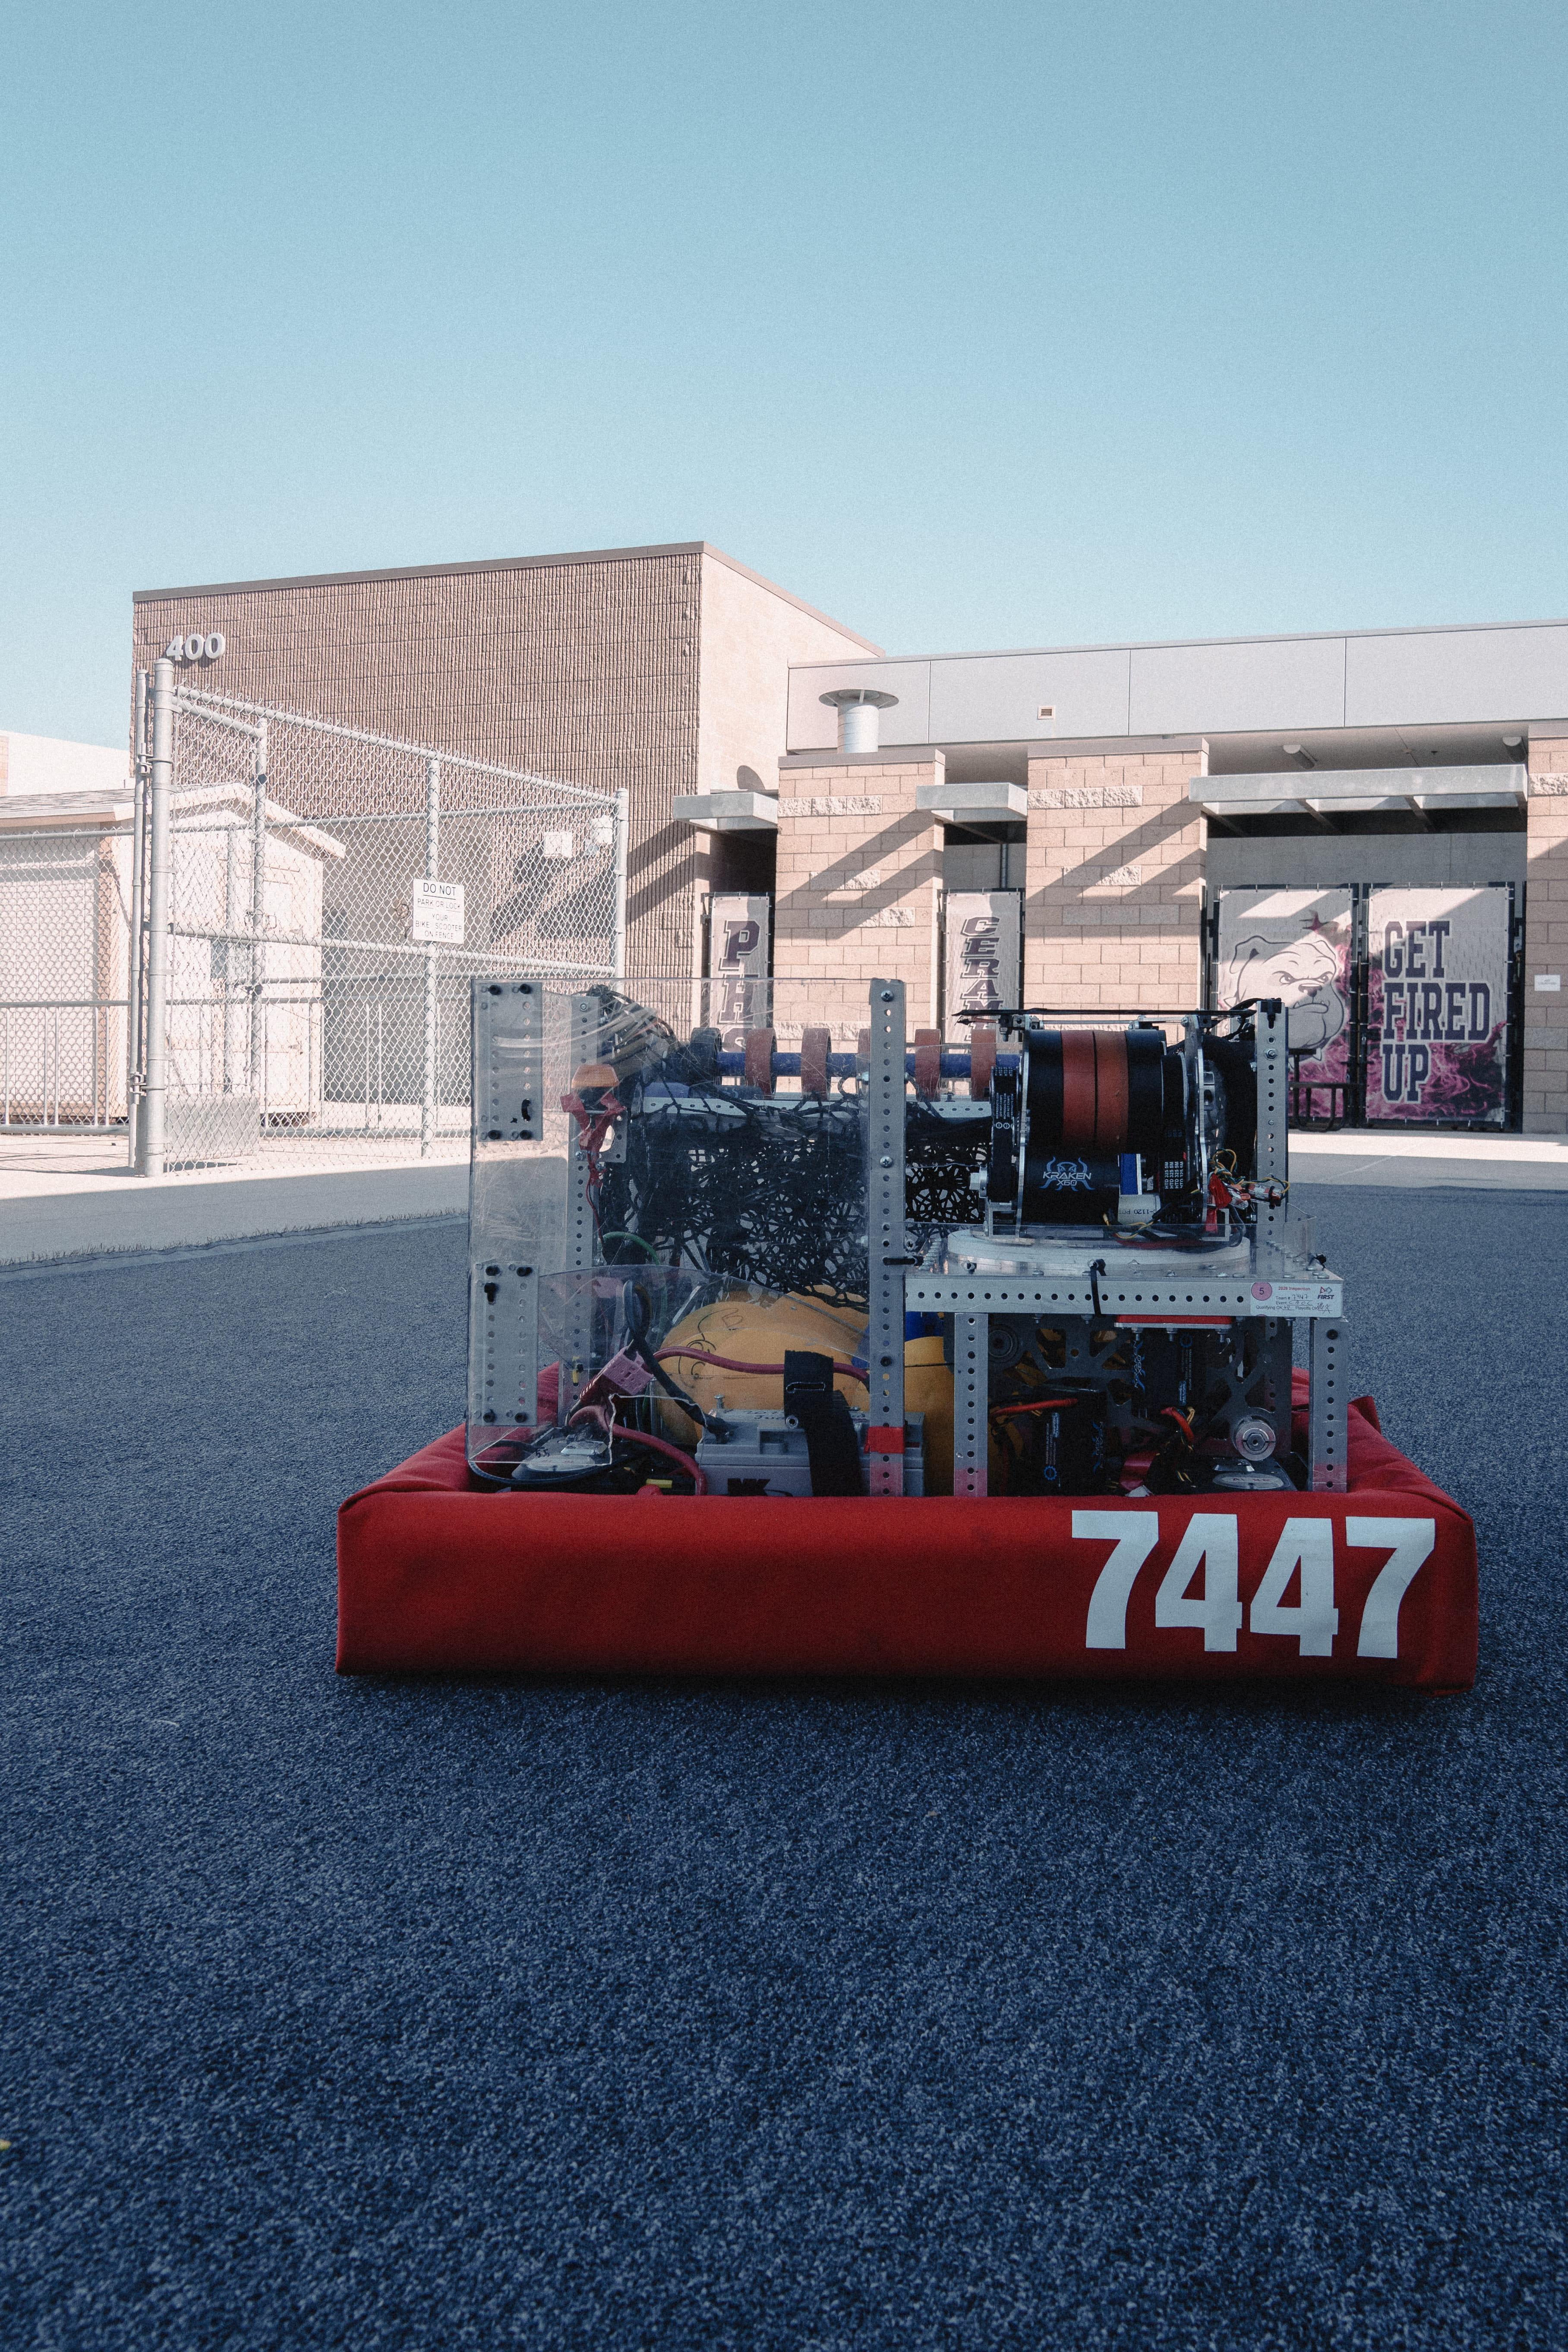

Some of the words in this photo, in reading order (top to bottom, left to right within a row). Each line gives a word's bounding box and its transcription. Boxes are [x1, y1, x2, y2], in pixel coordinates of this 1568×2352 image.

[166, 632, 226, 661] 400
[423, 883, 436, 893] DO
[439, 885, 456, 895] NOT
[435, 923, 462, 931] SCOOTER
[435, 931, 454, 940] FENCE
[1383, 920, 1450, 979] GET
[1383, 982, 1491, 1041] FIRED
[1382, 1043, 1430, 1102] UP
[1043, 1171, 1092, 1180] KRAKEN
[1071, 1510, 1435, 1659] 7447
